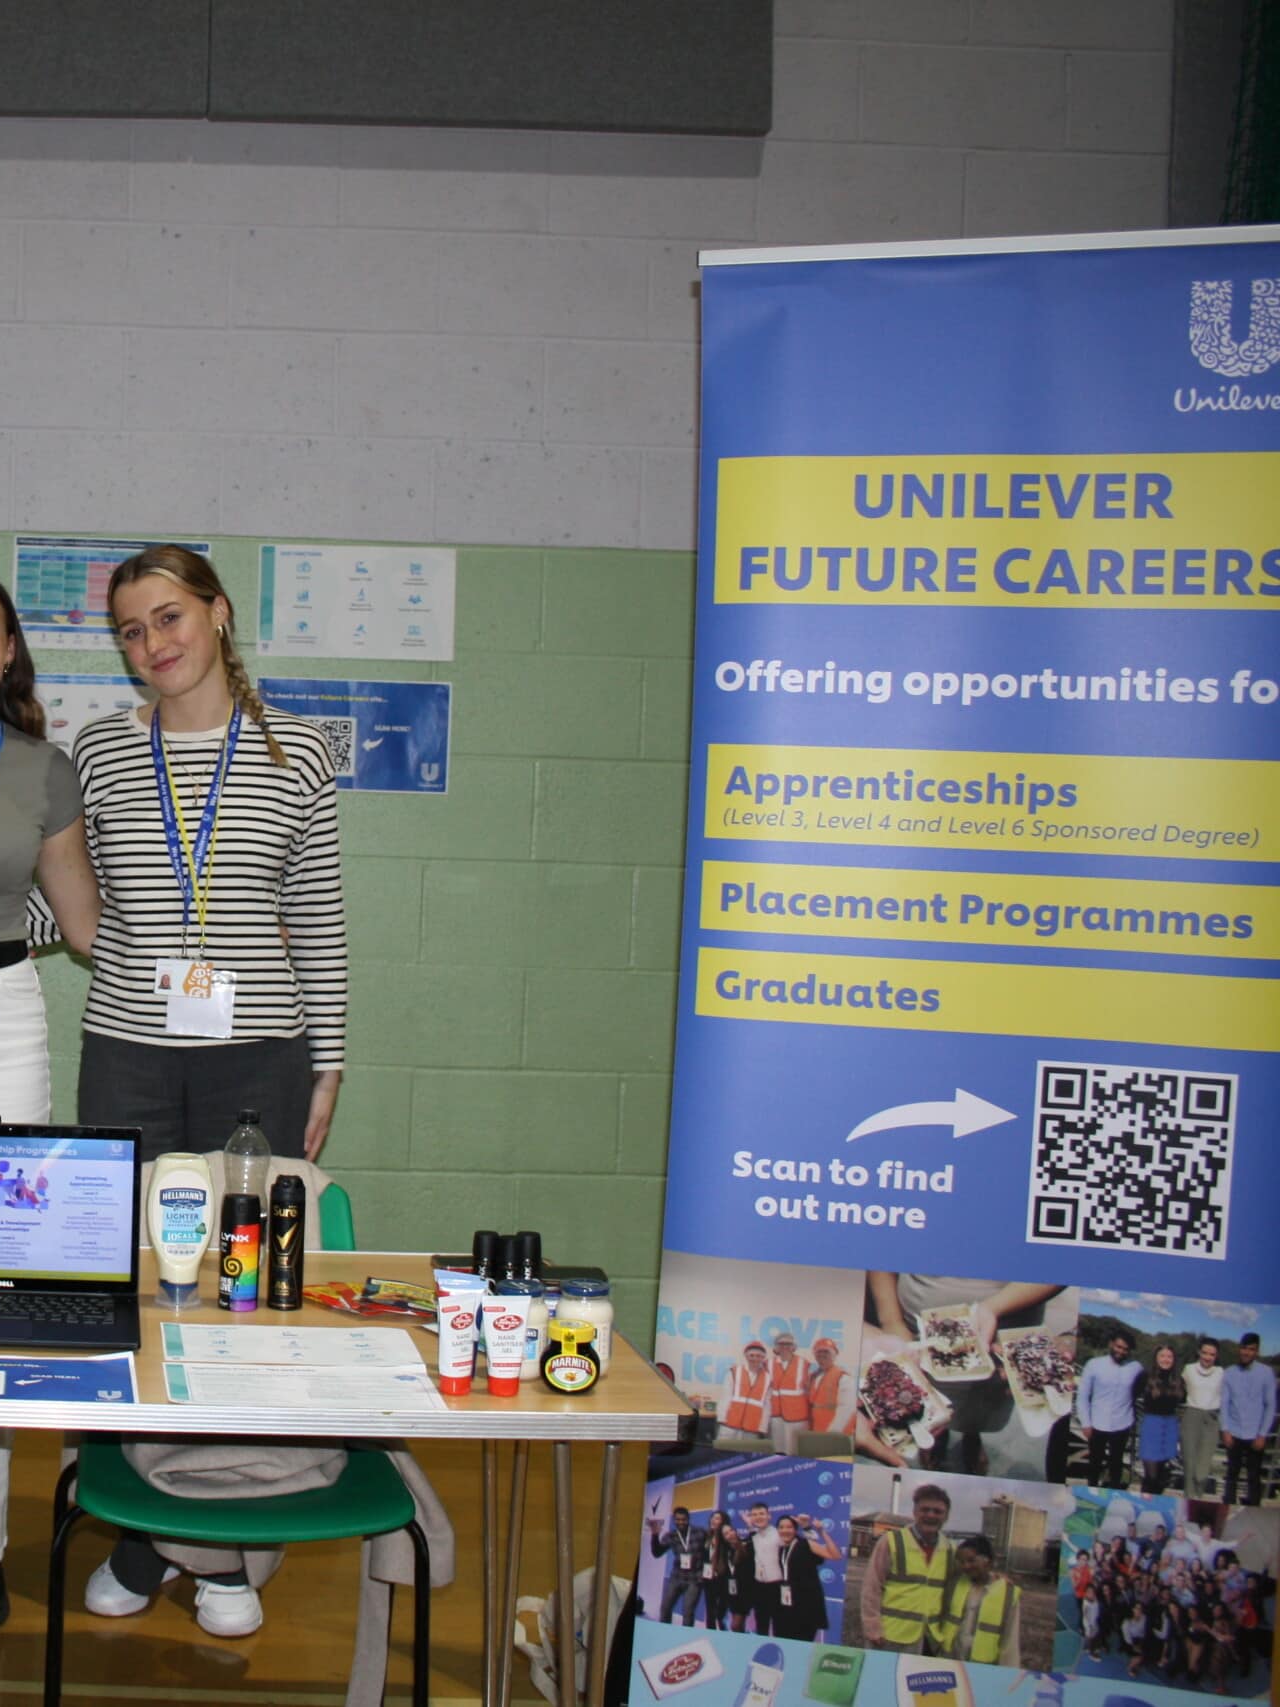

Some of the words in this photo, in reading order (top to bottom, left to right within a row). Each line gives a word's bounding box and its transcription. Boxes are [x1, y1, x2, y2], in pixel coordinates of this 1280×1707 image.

[854, 472, 1173, 519] UNILEVER
[739, 547, 977, 592] FUTURE
[993, 548, 1280, 595] CAREERS
[715, 660, 892, 703] Offering
[903, 666, 1218, 705] opportunities
[724, 766, 1078, 815] Apprenticeships
[722, 807, 786, 829] (Level
[792, 810, 809, 831] 3,
[816, 811, 874, 832] Level
[878, 814, 890, 832] 4
[897, 813, 942, 835] and
[948, 815, 1006, 837] Level
[1011, 819, 1025, 837] 6
[1030, 820, 1157, 845] Sponsored
[1163, 825, 1261, 848] Degree)
[719, 882, 948, 925] Placement
[959, 894, 1253, 940] Programmes
[715, 970, 940, 1013] Graduates
[16, 1146, 78, 1157] Prograes
[732, 1150, 822, 1184] Scan
[828, 1158, 869, 1189] to
[876, 1161, 955, 1194] find
[754, 1195, 820, 1222] out
[826, 1200, 926, 1229] more
[221, 1231, 249, 1243] LYNX
[551, 1357, 591, 1370] MARMITE
